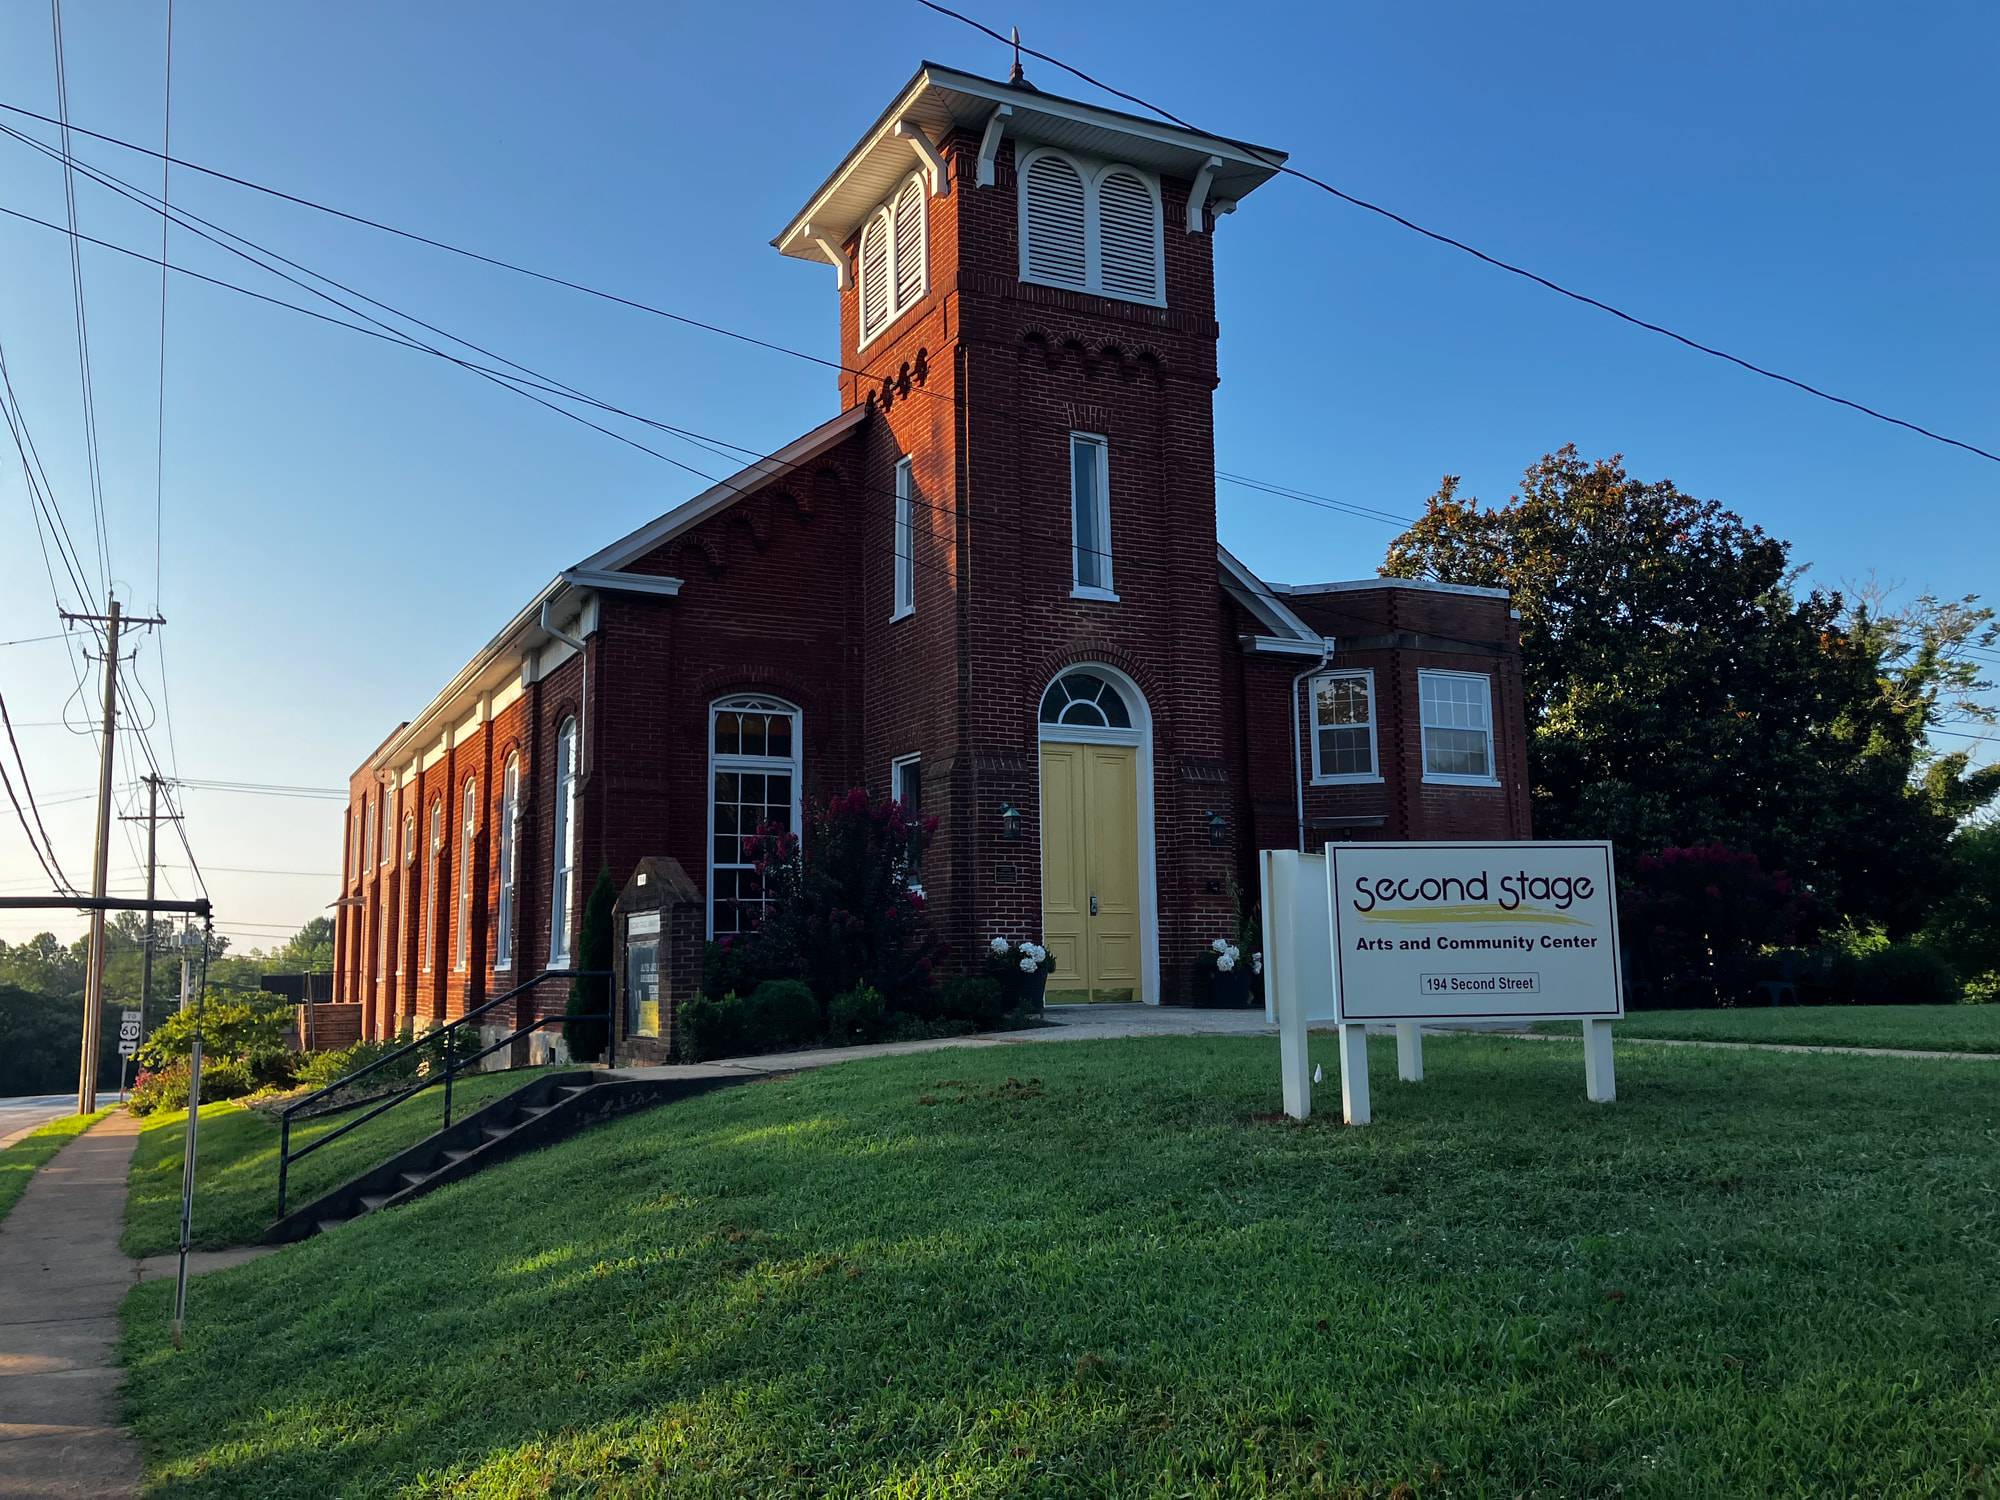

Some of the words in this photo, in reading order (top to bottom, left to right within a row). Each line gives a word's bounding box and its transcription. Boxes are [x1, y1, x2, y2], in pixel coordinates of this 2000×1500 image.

[1356, 937, 1394, 951] Arts
[1399, 937, 1431, 951] and
[1436, 935, 1535, 952] Community
[1540, 935, 1598, 949] Center
[1426, 978, 1448, 991] 194
[1450, 977, 1496, 991] Second
[1498, 976, 1534, 990] Street
[122, 1026, 138, 1036] 60
